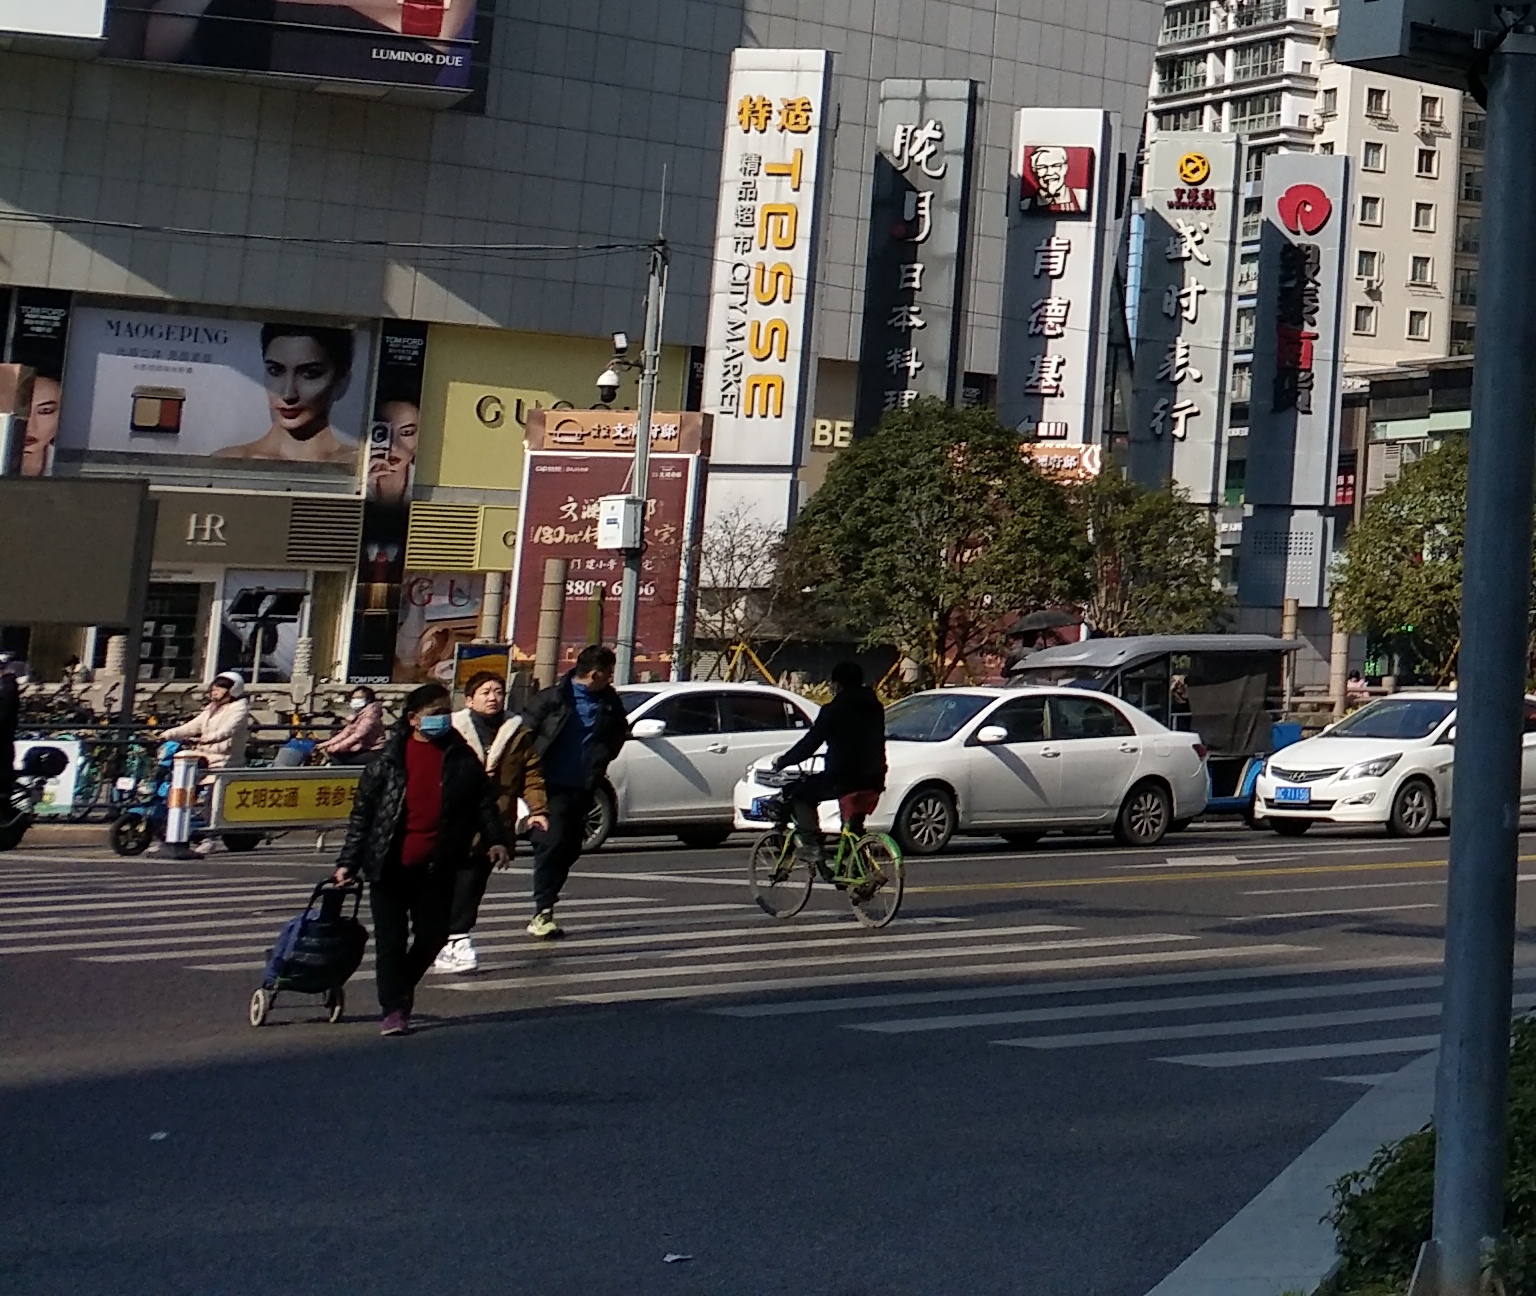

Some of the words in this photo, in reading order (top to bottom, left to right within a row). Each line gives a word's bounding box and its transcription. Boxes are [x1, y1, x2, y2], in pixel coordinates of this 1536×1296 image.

[371, 48, 434, 64] LUMINOR
[435, 54, 463, 66] DUE
[738, 94, 813, 134] 特适
[733, 152, 762, 255] 精品超市
[729, 261, 752, 319] CITY
[105, 319, 229, 345] MAOGEPING
[1024, 236, 1071, 397] 肯德基
[1150, 217, 1211, 439] 盛时表行
[720, 320, 748, 418] MARKET
[185, 513, 226, 542] HR
[236, 789, 299, 809] 文明交通
